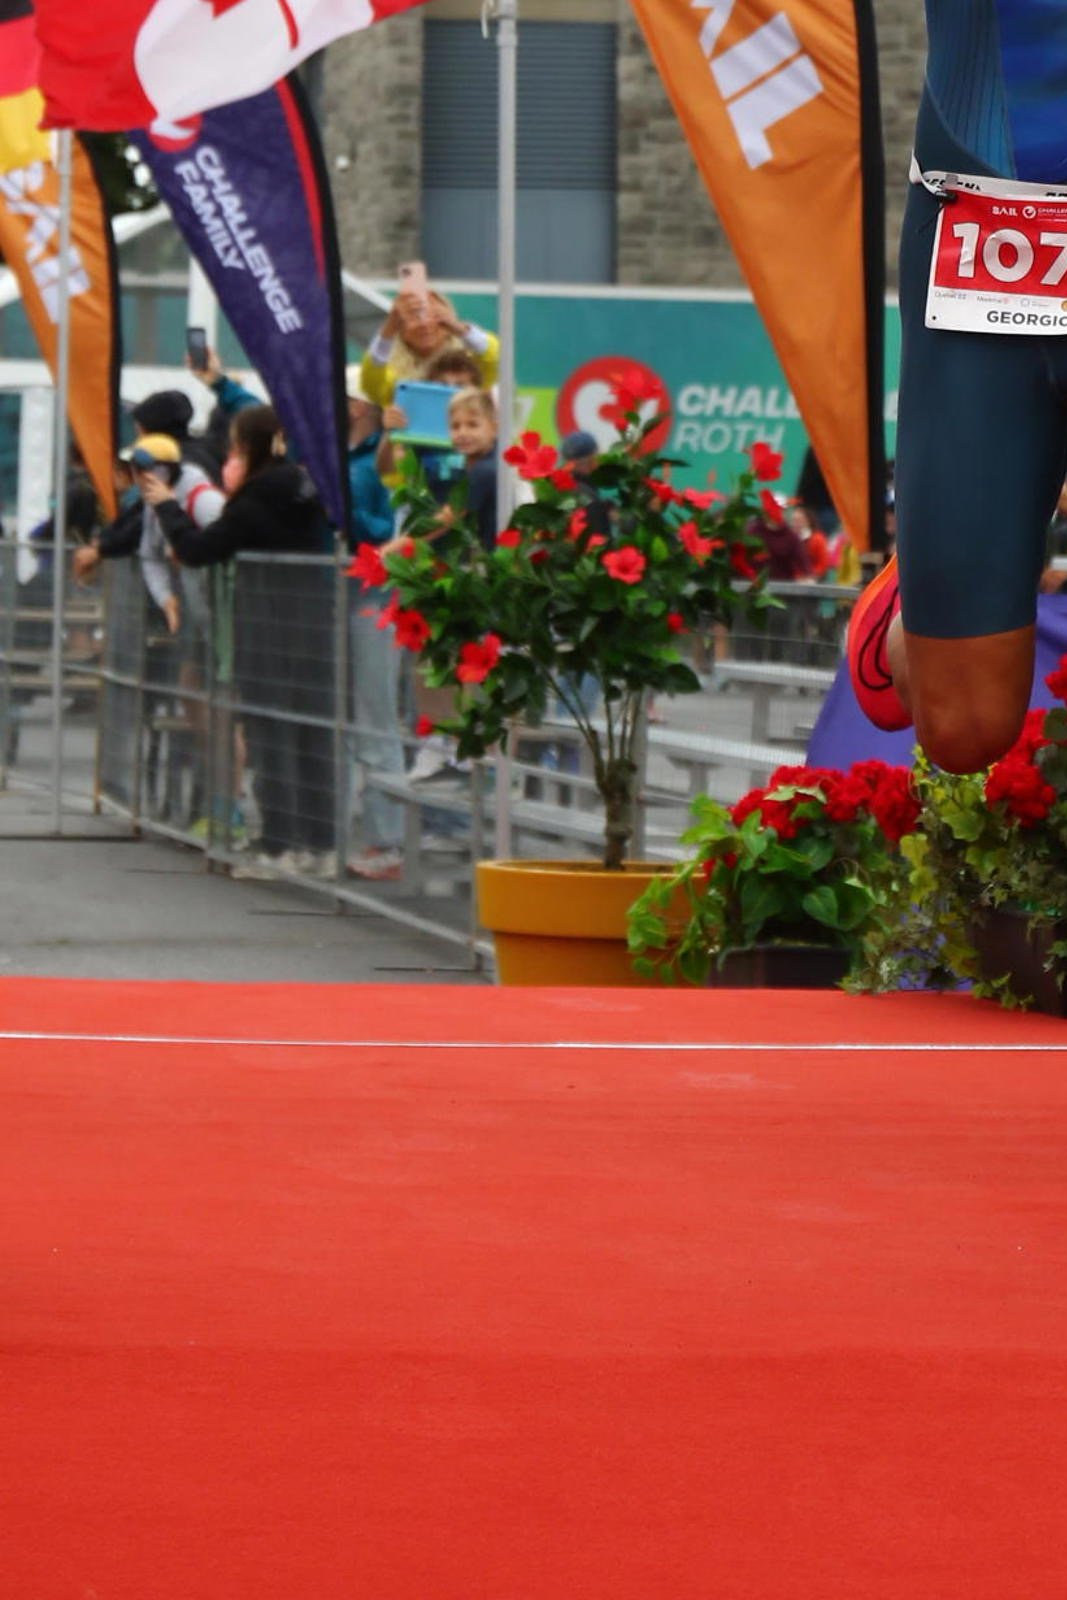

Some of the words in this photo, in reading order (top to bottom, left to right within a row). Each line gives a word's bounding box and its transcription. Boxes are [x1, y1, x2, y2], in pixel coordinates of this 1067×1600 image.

[174, 160, 245, 270] FAMILY
[195, 144, 303, 335] CHALLENGE
[992, 205, 1018, 217] SAIL
[672, 420, 785, 454] ROTH
